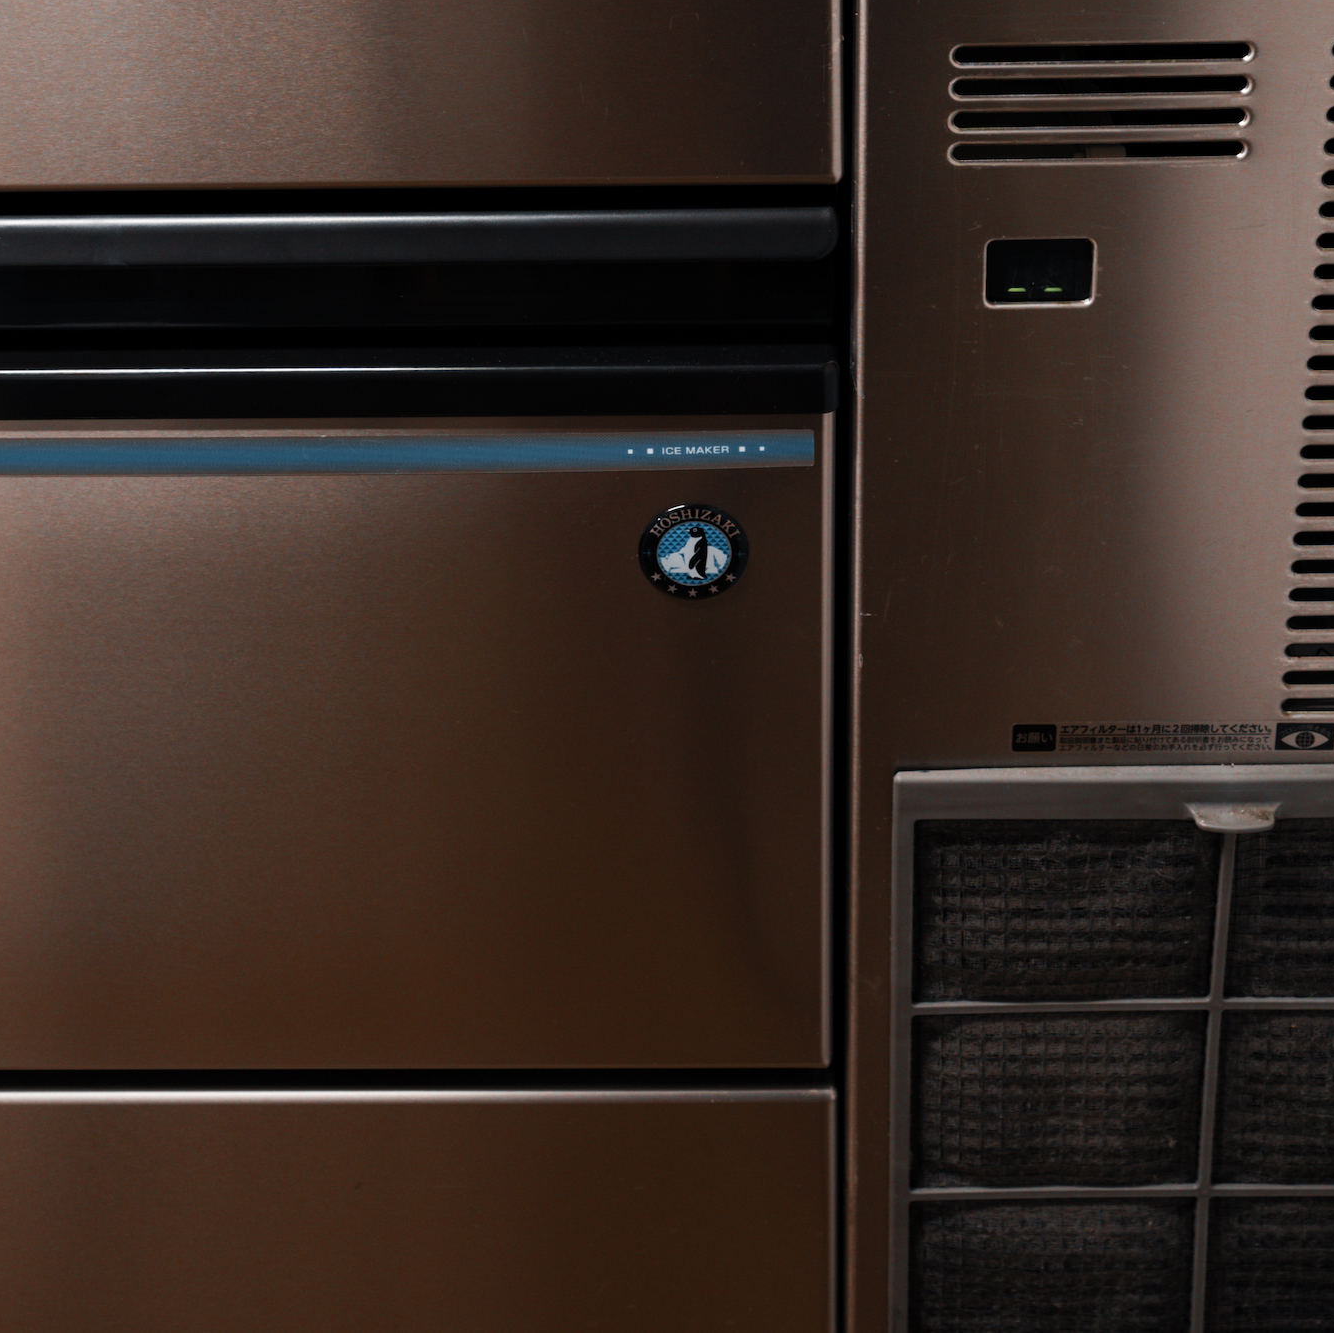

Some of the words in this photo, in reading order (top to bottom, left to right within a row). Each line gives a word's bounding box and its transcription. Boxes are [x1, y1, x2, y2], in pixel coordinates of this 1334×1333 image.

[661, 446, 682, 455] ICE
[685, 445, 730, 455] MAKER
[649, 508, 741, 539] HOSHIZAKI
[1015, 731, 1054, 744] お願い
